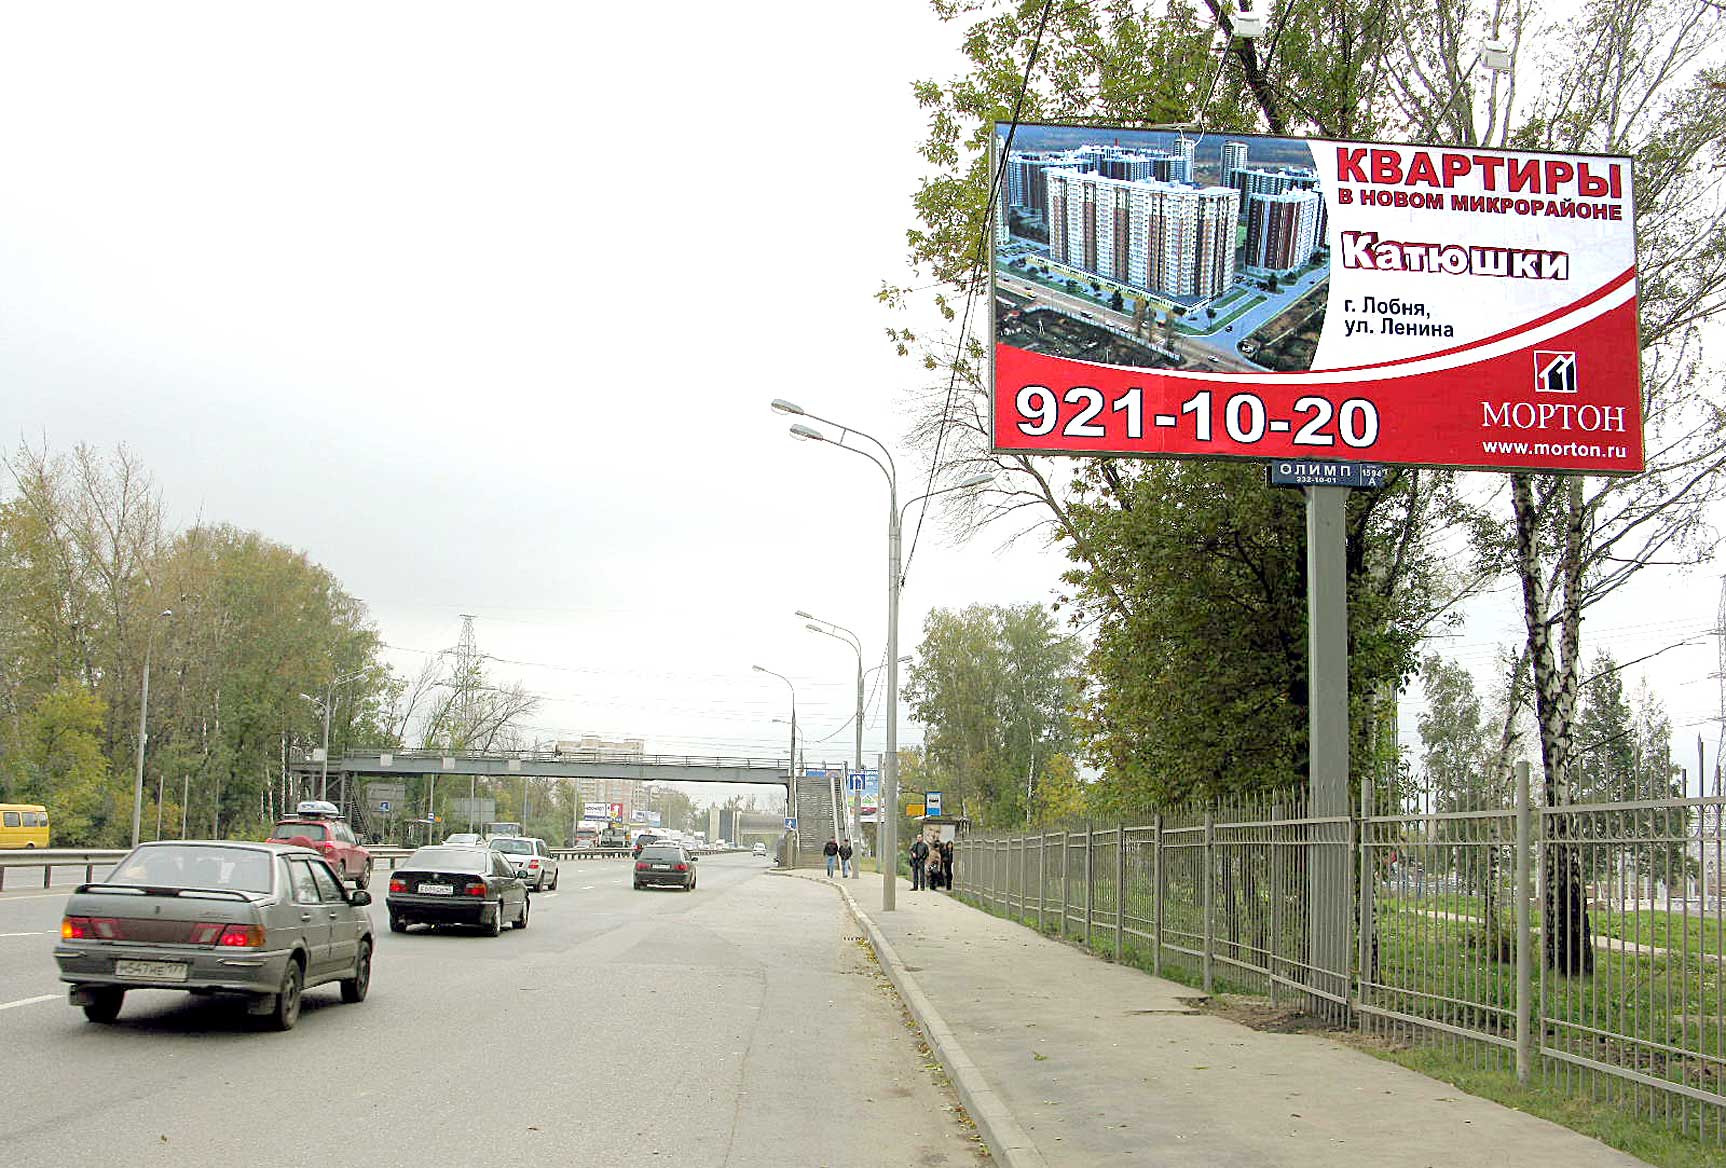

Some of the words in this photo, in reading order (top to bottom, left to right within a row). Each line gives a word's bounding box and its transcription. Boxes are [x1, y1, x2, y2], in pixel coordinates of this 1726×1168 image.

[1336, 147, 1622, 199] КВАРТИРЫ
[1339, 188, 1353, 204] В
[1360, 189, 1444, 210] НОВОМ
[1451, 194, 1623, 221] МИКРОРАЙОНЕ
[1341, 231, 1569, 280] Катюшки
[1344, 299, 1356, 312] г.
[1362, 296, 1431, 319] Лобня,
[1344, 319, 1374, 337] ул.
[1380, 317, 1454, 337] Ленина
[1014, 384, 1380, 448] 921-10-20
[1481, 402, 1626, 432] МОРТОН
[1482, 441, 1627, 458] www.morton.ru
[1280, 463, 1351, 477] ОЛИМП
